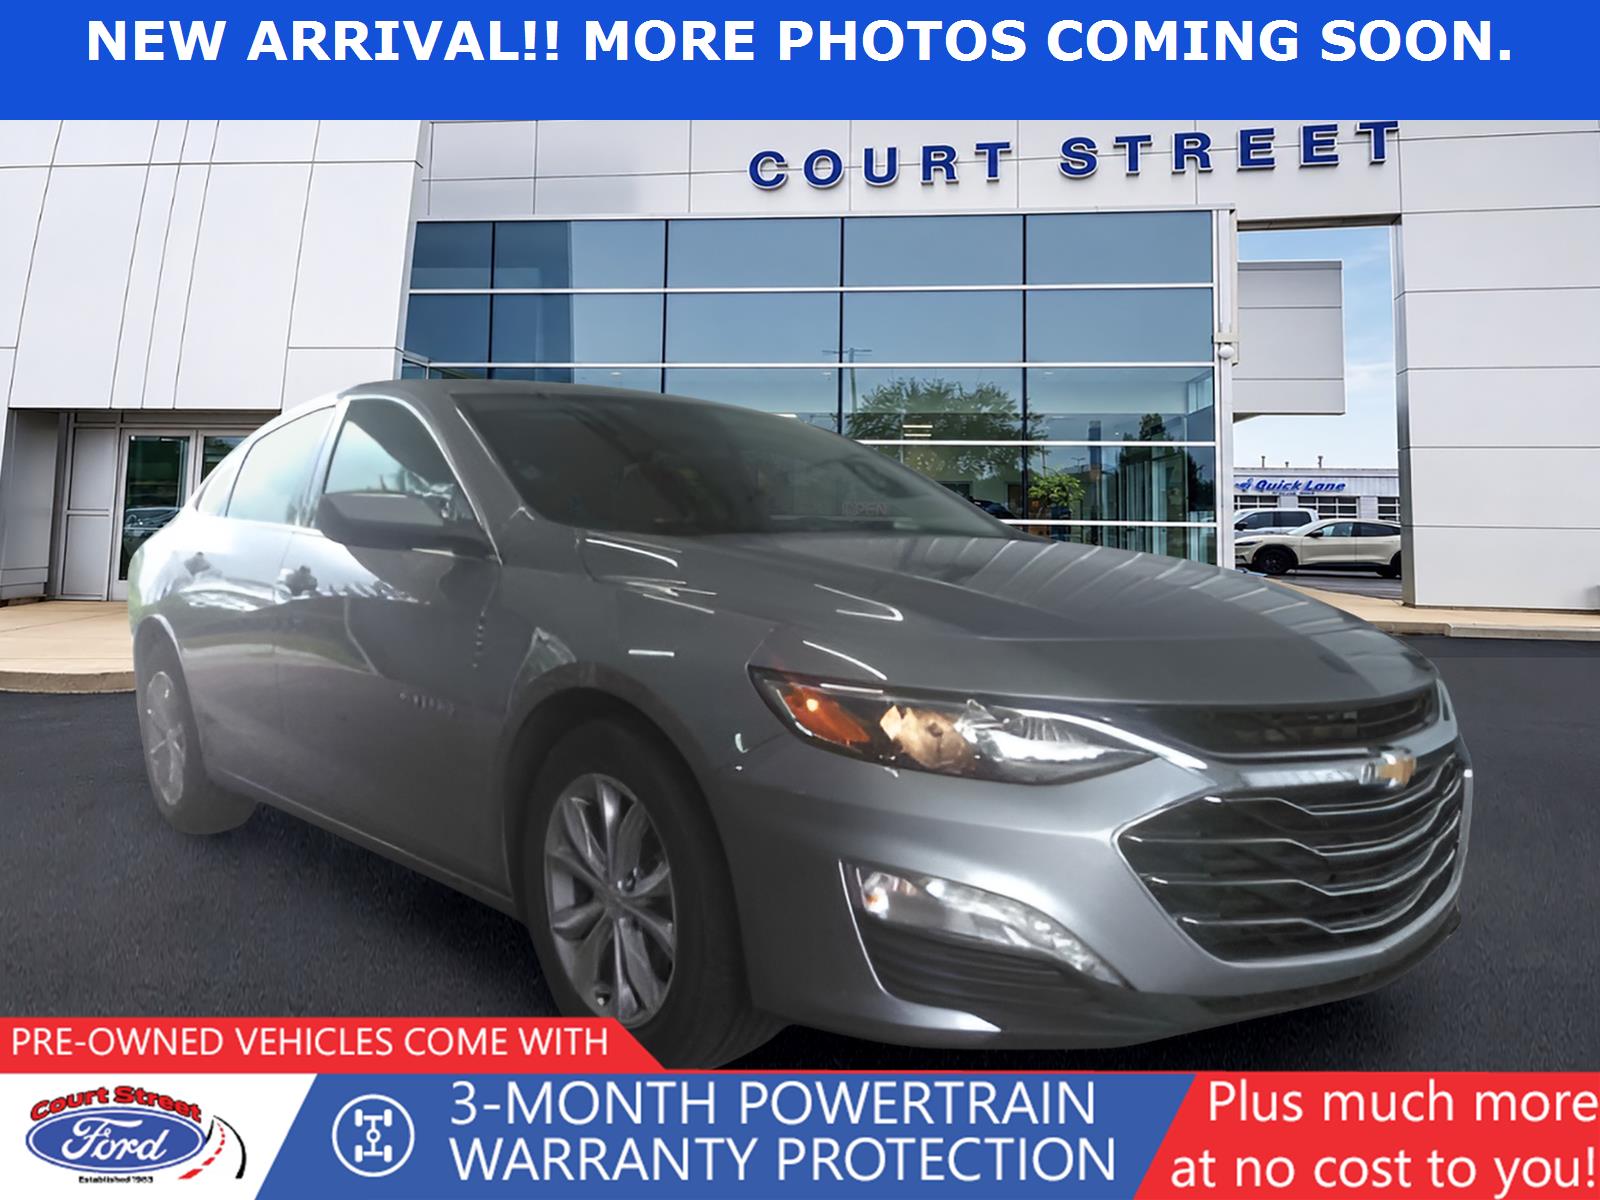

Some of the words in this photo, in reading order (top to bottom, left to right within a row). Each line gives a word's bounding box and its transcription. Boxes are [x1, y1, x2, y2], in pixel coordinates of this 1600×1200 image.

[749, 140, 1012, 190] COURT
[1059, 119, 1399, 178] STREET
[1254, 479, 1301, 491] Quick
[1303, 480, 1346, 492] Lane
